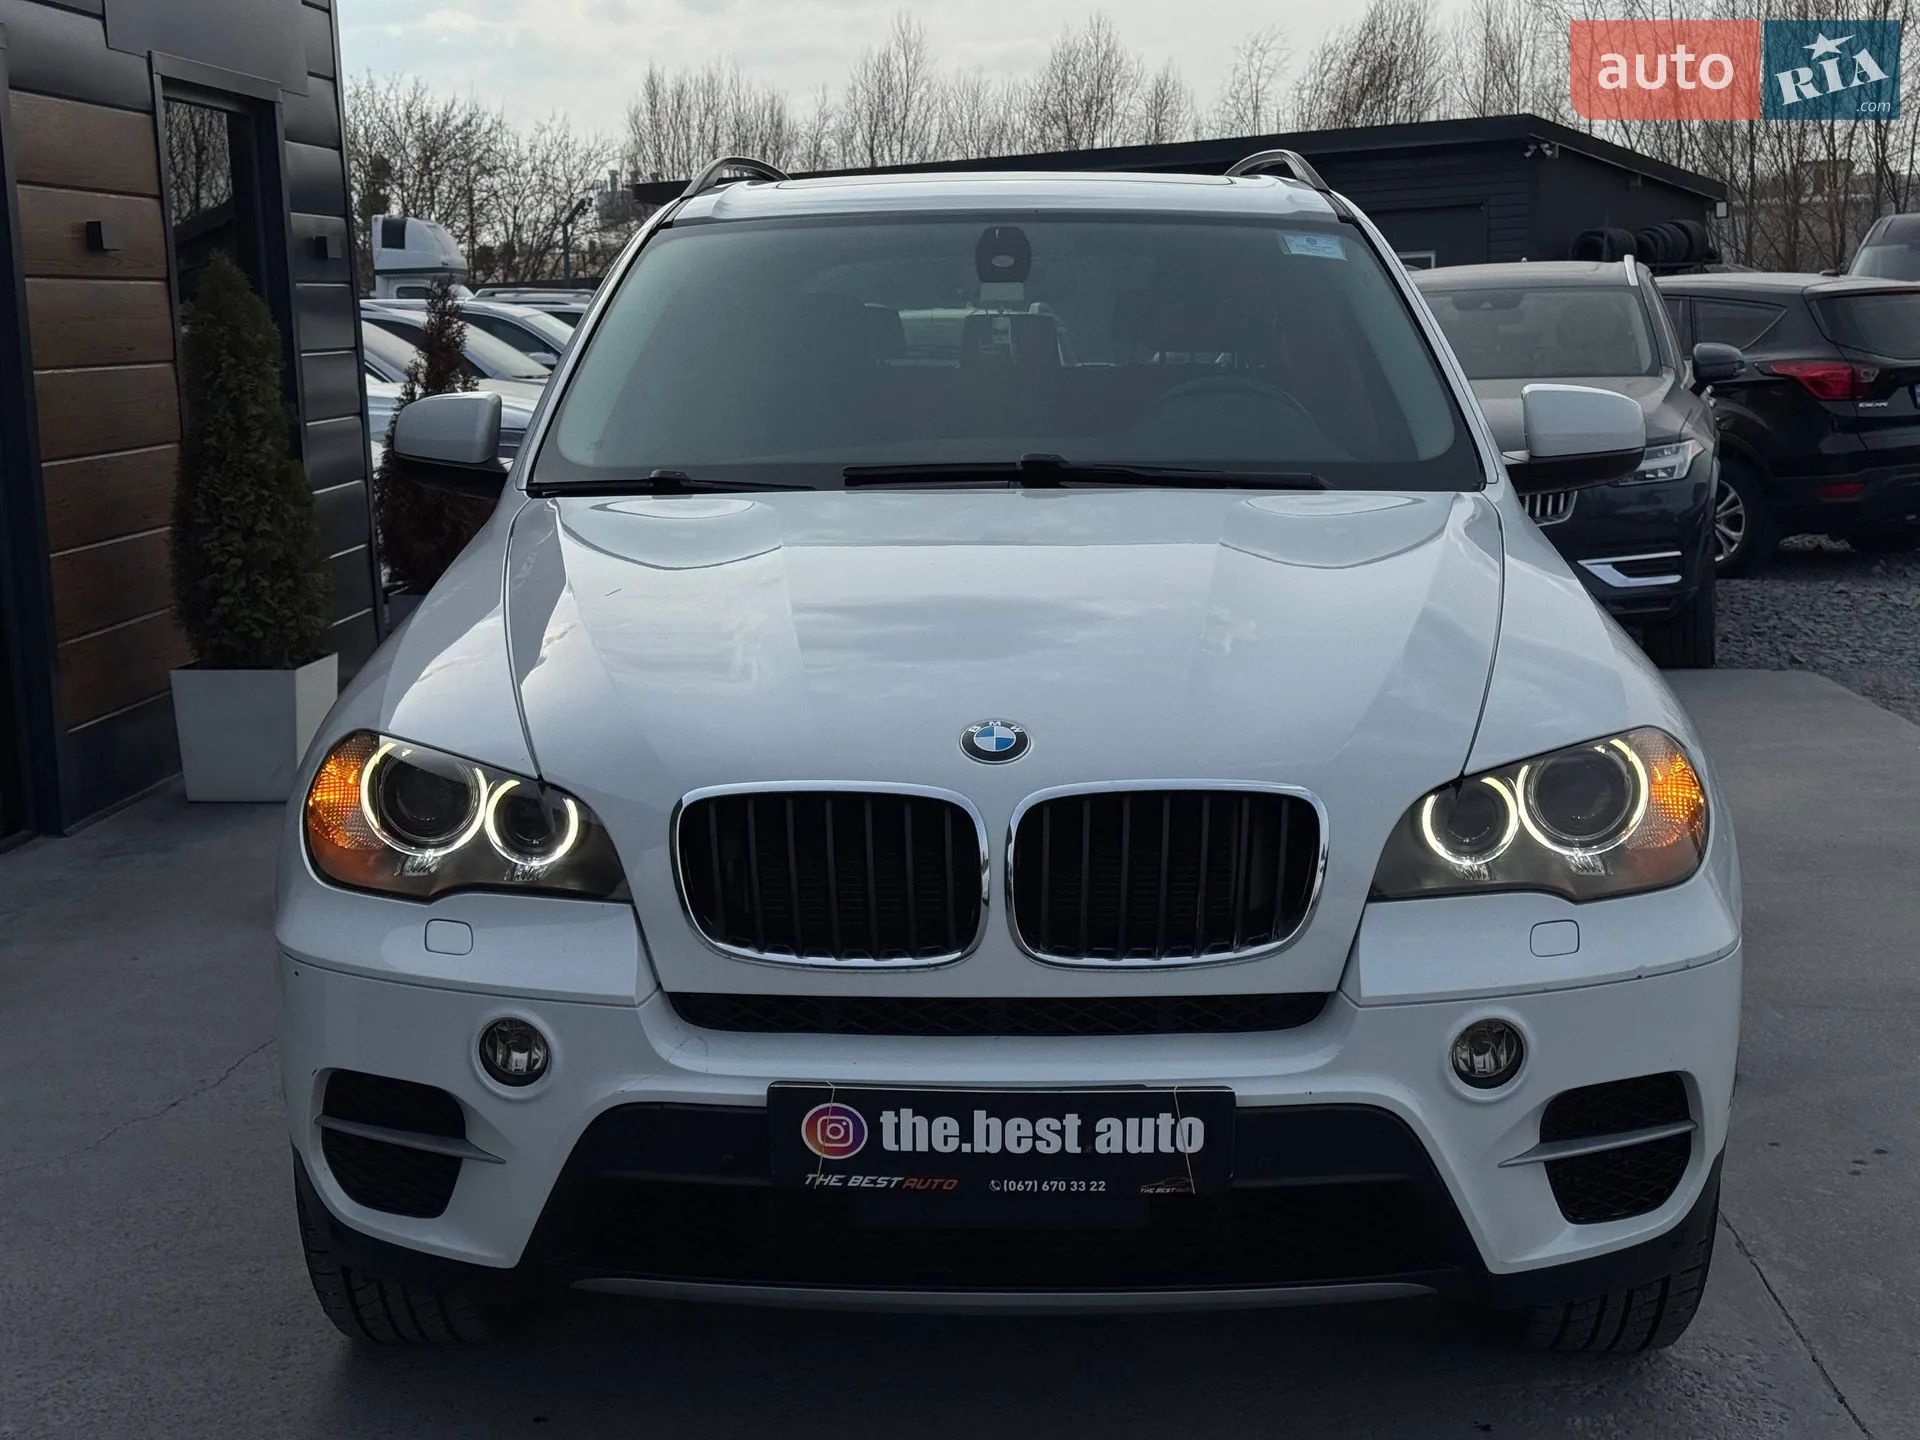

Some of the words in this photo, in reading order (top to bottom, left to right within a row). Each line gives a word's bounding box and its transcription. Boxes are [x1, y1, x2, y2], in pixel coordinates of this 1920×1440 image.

[879, 1108, 1082, 1154] the.best
[1095, 1112, 1205, 1154] auto
[805, 1173, 847, 1187] THE
[1003, 1179, 1038, 1192] (067)
[1041, 1180, 1066, 1192] 670
[1070, 1180, 1086, 1192] 33
[1089, 1180, 1106, 1192] 22
